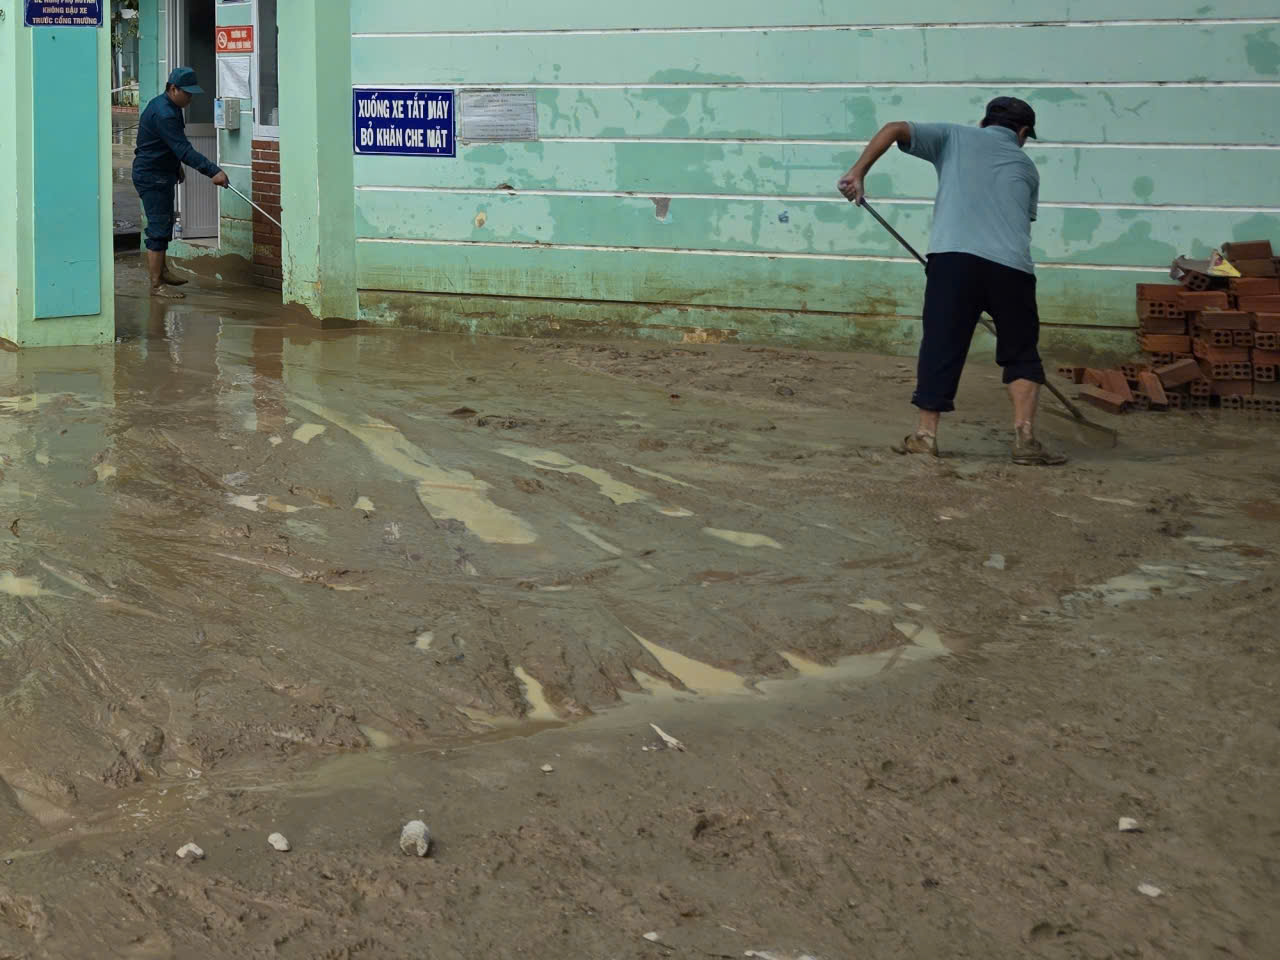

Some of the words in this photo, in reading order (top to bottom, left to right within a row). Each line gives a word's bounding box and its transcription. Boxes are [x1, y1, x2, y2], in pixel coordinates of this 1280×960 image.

[358, 92, 390, 118] XUỐNG
[392, 100, 404, 119] XE
[407, 92, 425, 119] TẮT
[427, 96, 449, 120] MÁY
[360, 121, 374, 146] BỎ
[377, 125, 403, 147] KHĂN
[405, 128, 424, 147] CHE
[427, 126, 448, 152] MẶT
